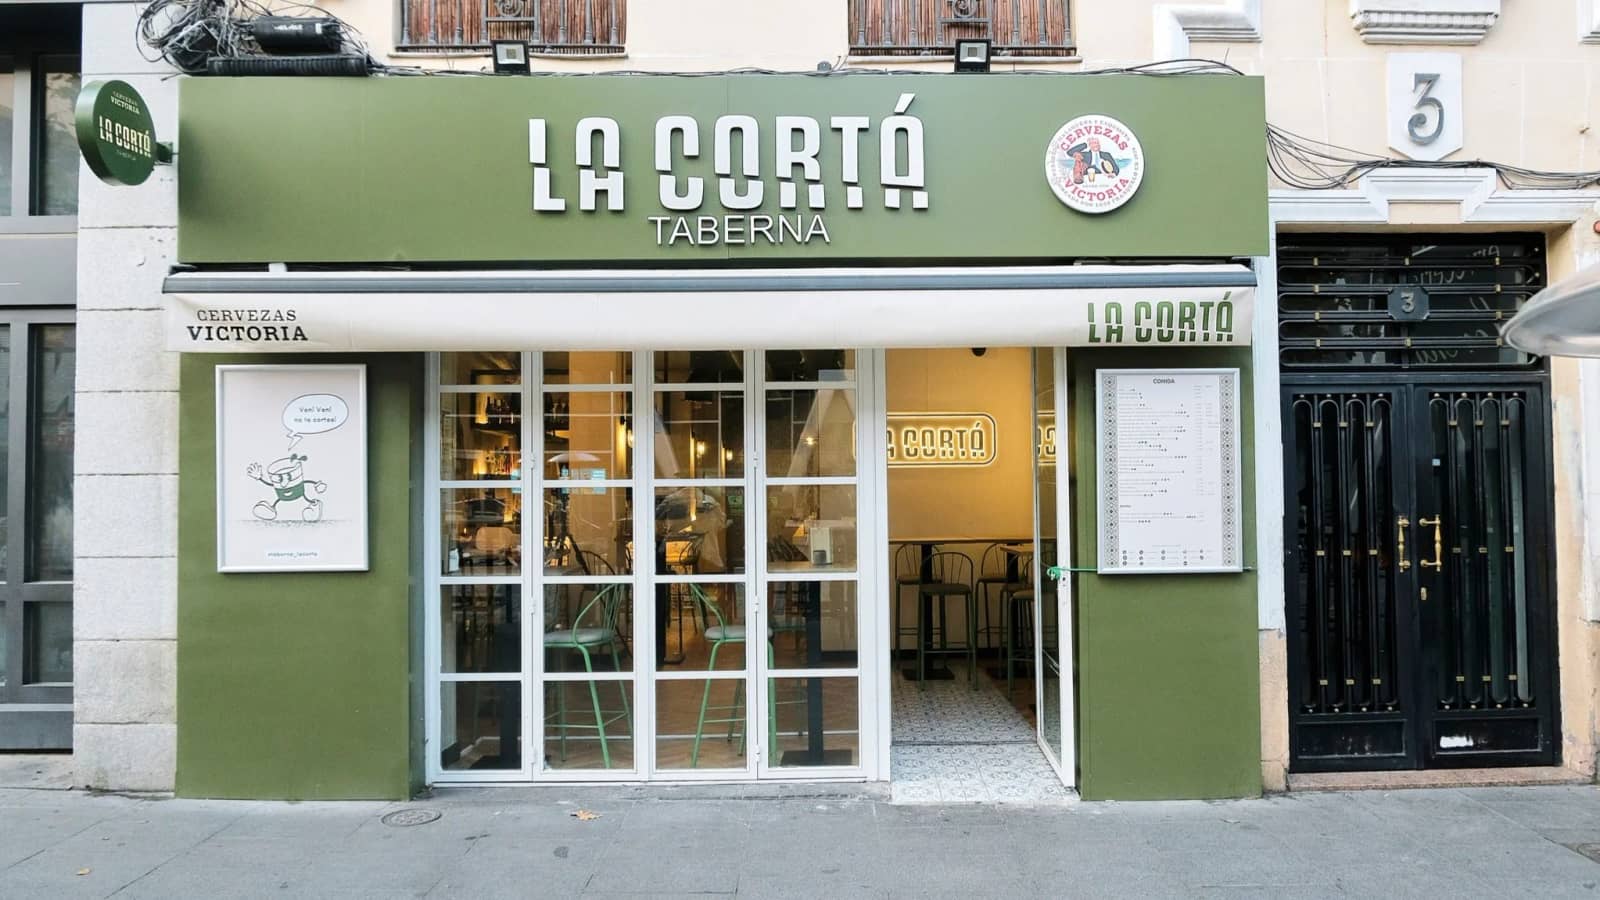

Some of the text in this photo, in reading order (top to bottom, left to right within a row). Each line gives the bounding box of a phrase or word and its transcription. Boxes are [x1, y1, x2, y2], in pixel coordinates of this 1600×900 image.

[110, 96, 140, 115] VICTORIA
[1407, 72, 1444, 146] 3
[99, 114, 152, 158] LA CORTÁ
[1060, 125, 1128, 151] CERVEZAS
[529, 115, 624, 211] LA
[654, 93, 929, 211] CORTÁ
[1064, 178, 1129, 201] VICTORIA
[647, 214, 831, 245] TABERNA
[196, 309, 297, 321] CERVEZAS
[1400, 292, 1415, 313] 3
[1087, 291, 1233, 343] LA CORTÁ
[186, 325, 309, 341] VICTORIA
[903, 423, 985, 457] CORTÁ
